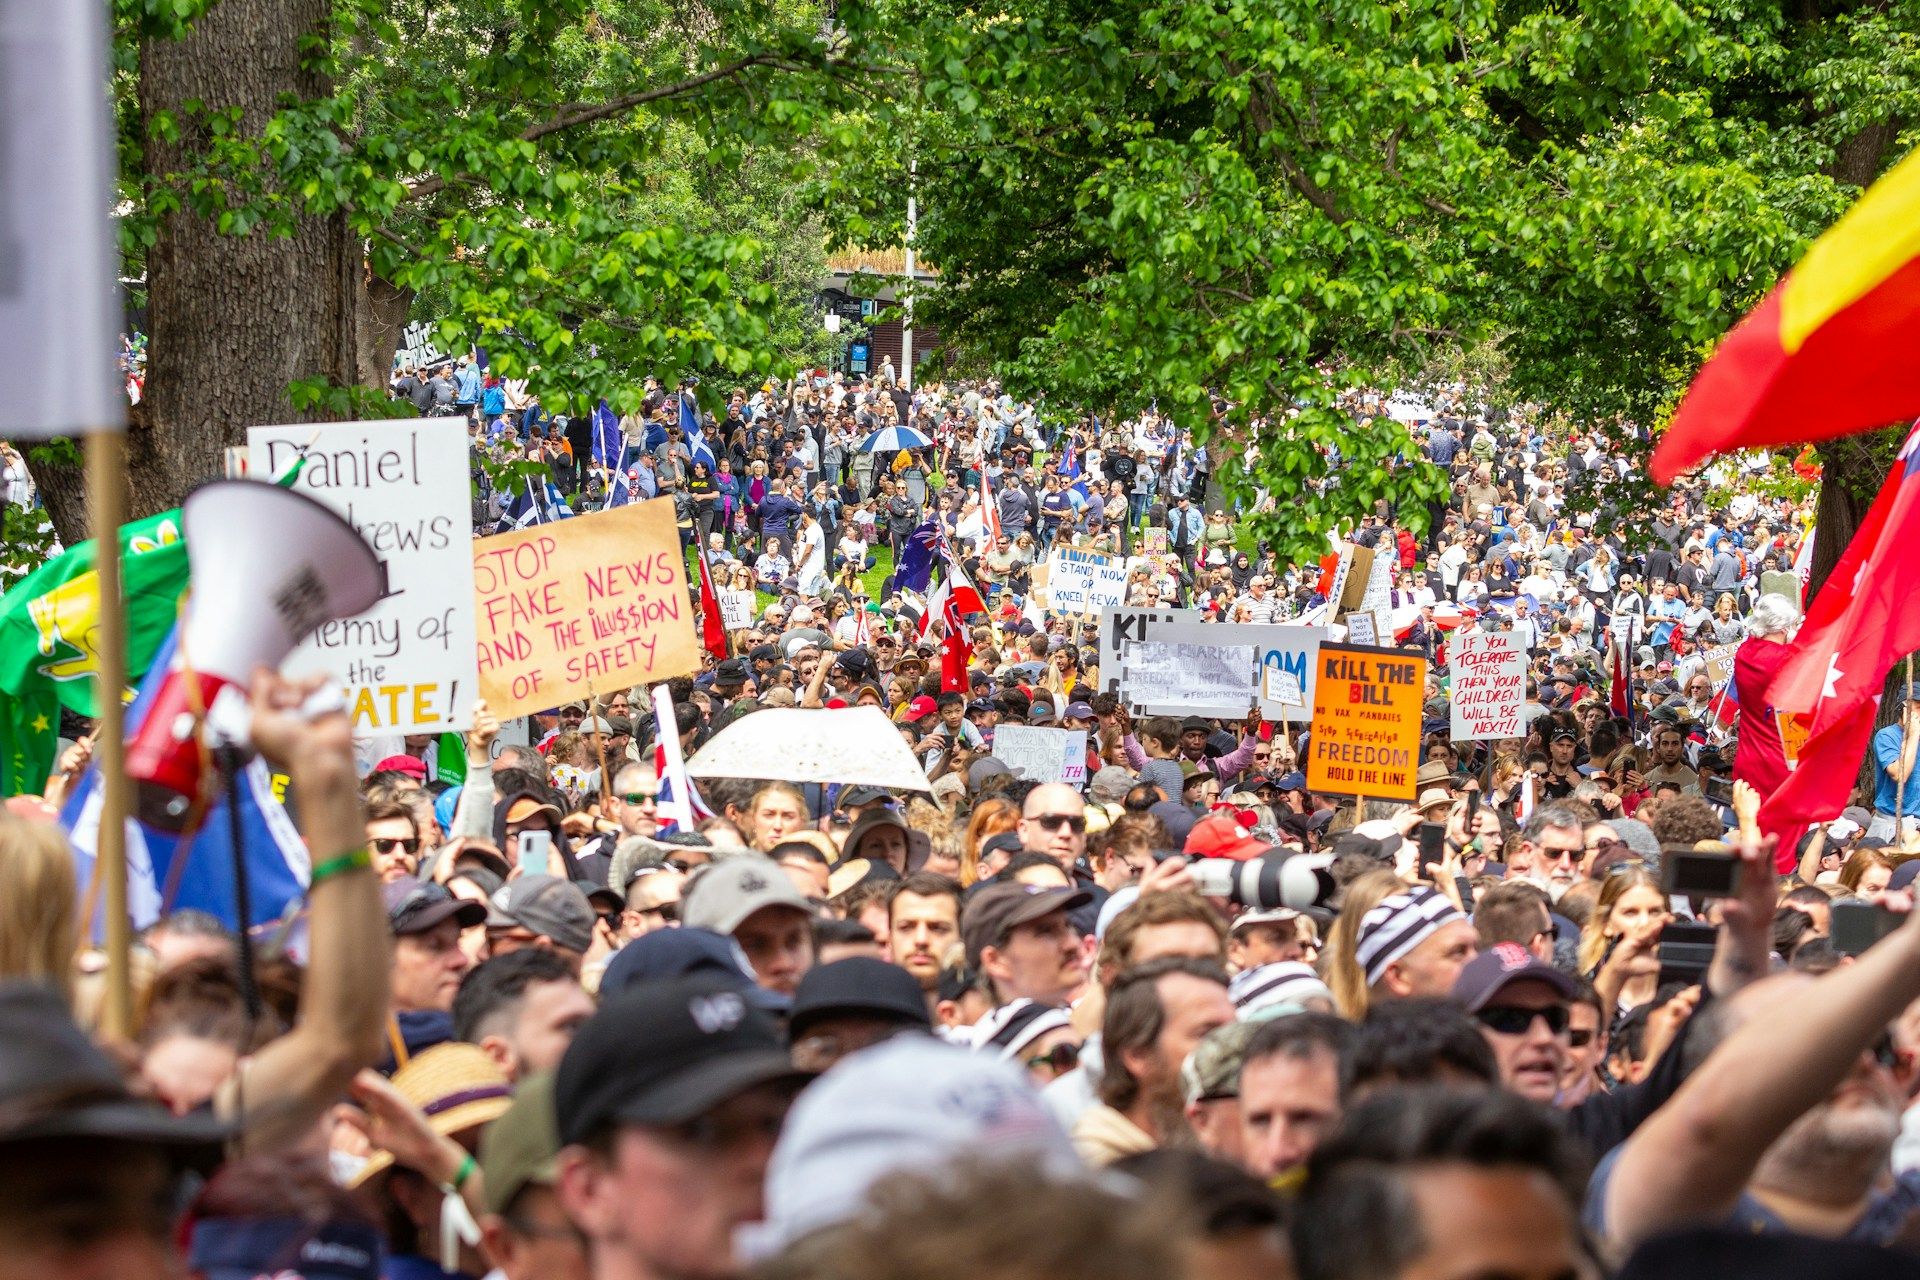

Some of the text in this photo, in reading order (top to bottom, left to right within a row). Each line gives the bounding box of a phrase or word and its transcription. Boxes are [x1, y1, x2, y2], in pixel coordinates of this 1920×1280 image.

[474, 537, 556, 595] STOP
[1060, 562, 1127, 582] STAND NOW
[1081, 579, 1094, 589] OR
[483, 552, 675, 635] FAKE NEWS
[721, 594, 741, 606] KILL
[1055, 589, 1119, 607] KNEEL 4EVA
[417, 607, 456, 650] of
[477, 630, 532, 674] AND
[544, 618, 585, 652] THE
[1177, 643, 1242, 660] PHARMA
[1463, 635, 1507, 650] IF YOU
[1455, 650, 1519, 668] TOLERATE
[1708, 648, 1729, 660] DAN
[348, 658, 386, 684] the
[511, 633, 658, 700] OF SAFETY
[1376, 663, 1416, 685] THE
[1471, 664, 1500, 676] THIS
[1128, 671, 1180, 685] FREEDOM
[1199, 672, 1222, 685] NOT
[1457, 675, 1521, 689] THEN YOUR
[1349, 683, 1393, 706] BILL
[1455, 688, 1521, 706] CHILDREN
[1316, 706, 1401, 723] NO VAX MANDATES
[1463, 704, 1520, 720] WILL BE
[1472, 718, 1519, 736] NEXT!!
[1317, 741, 1409, 768] FREEDOM
[1327, 766, 1354, 781] HOLD
[1359, 769, 1378, 784] THE
